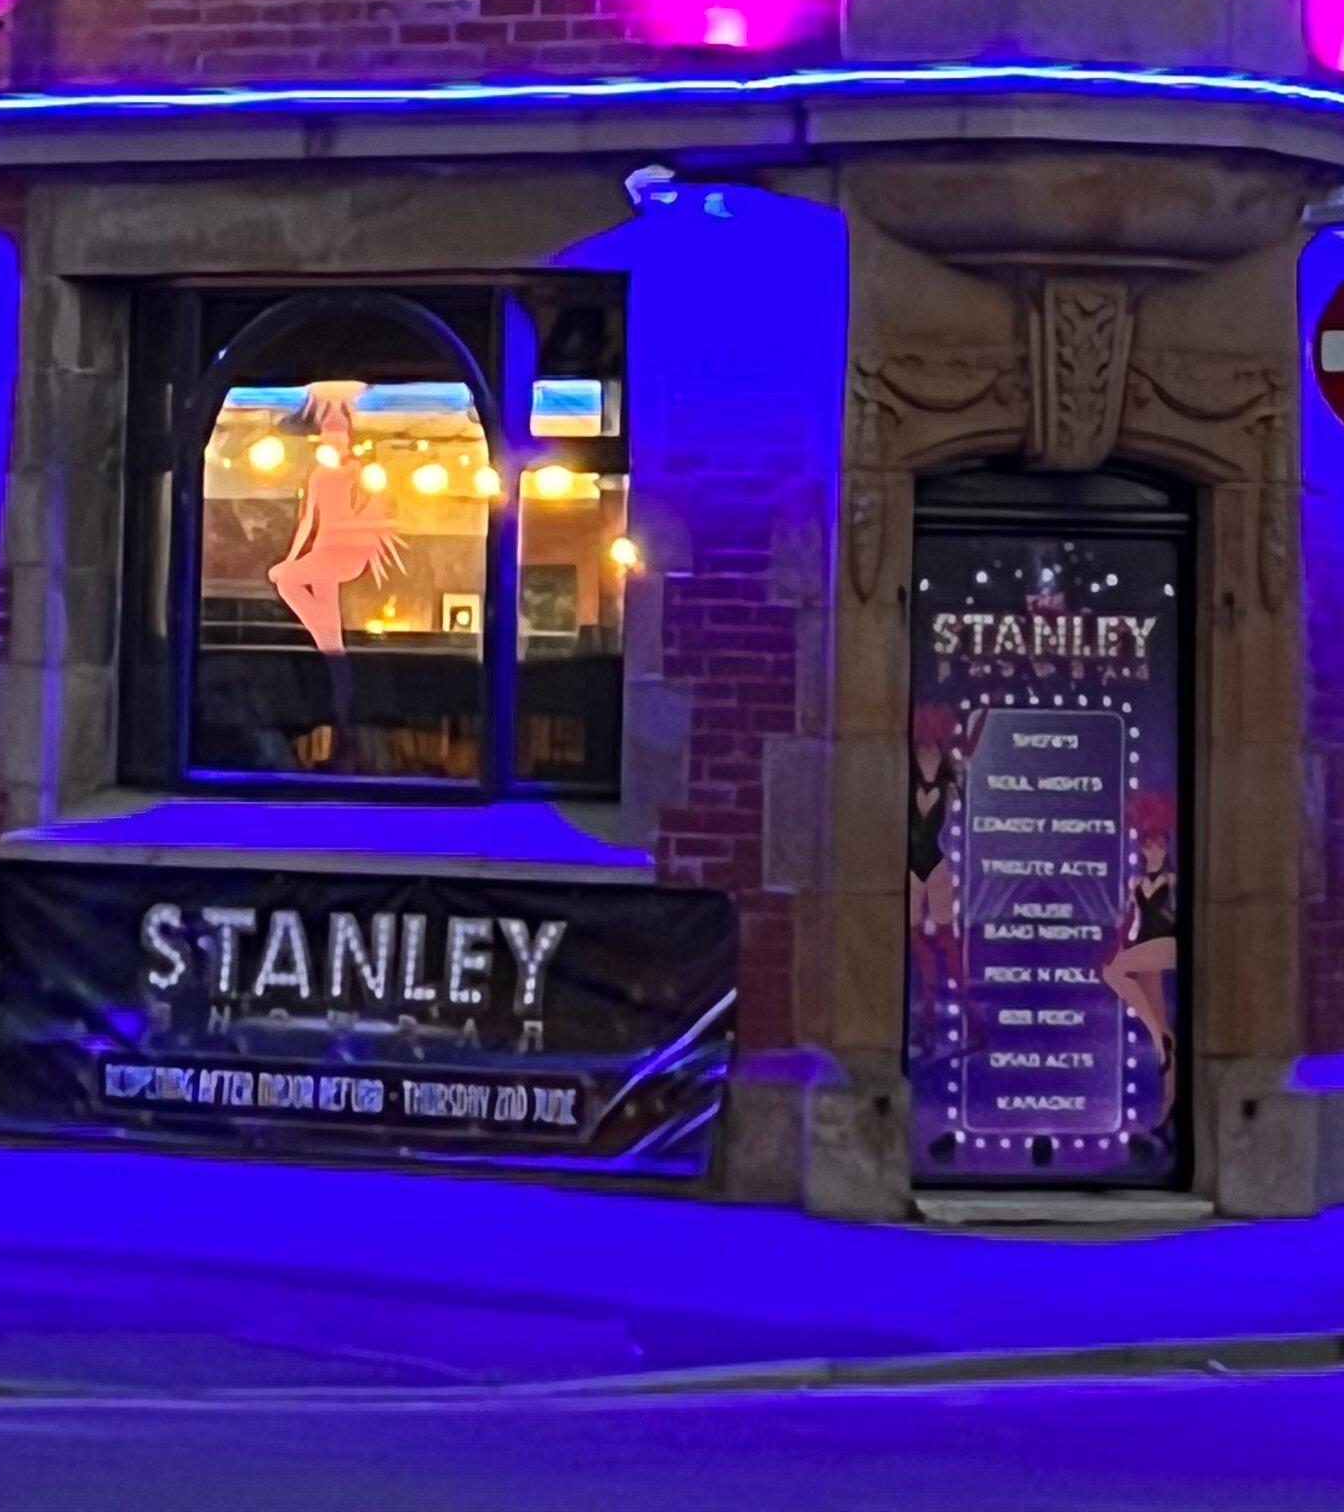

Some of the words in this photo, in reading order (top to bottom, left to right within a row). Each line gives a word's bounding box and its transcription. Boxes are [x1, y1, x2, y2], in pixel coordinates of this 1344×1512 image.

[932, 613, 1157, 658] STANLEY
[980, 858, 1055, 876] TRIBUTE
[1059, 860, 1108, 876] ACTS
[142, 901, 568, 1011] STANLEY
[983, 966, 1032, 982] ROCK
[1054, 968, 1101, 984] ROLL
[1045, 1052, 1094, 1068] ACTS
[197, 1068, 255, 1106] AFTER
[402, 1079, 491, 1119] THURSDAY
[996, 1095, 1087, 1111] KARAOKE
